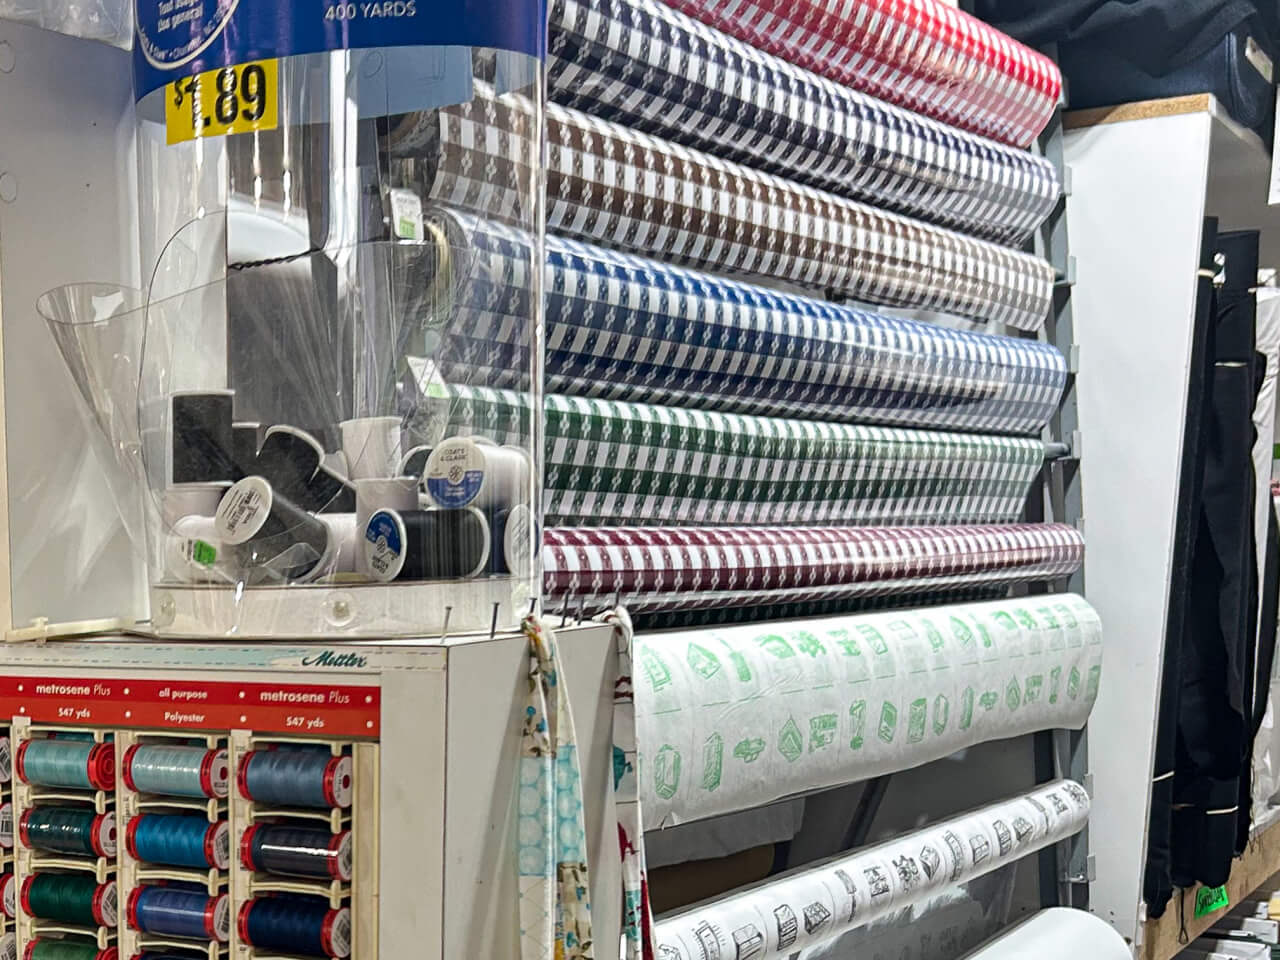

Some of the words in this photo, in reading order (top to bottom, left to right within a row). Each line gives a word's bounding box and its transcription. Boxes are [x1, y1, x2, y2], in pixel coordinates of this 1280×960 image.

[324, 4, 357, 20] 400
[361, 2, 417, 19] YARDS
[173, 64, 266, 130] $1.89
[301, 650, 367, 669] Mettler
[36, 683, 91, 697] metrosene
[93, 683, 111, 697] Plus
[158, 688, 172, 699] all
[173, 689, 208, 702] purpose
[259, 689, 325, 704] metrosene
[328, 690, 350, 705] Plus
[57, 706, 74, 718] 547
[75, 707, 91, 720] yds
[164, 711, 206, 725] Polyester
[286, 716, 303, 729] 547
[306, 716, 325, 730] yds
